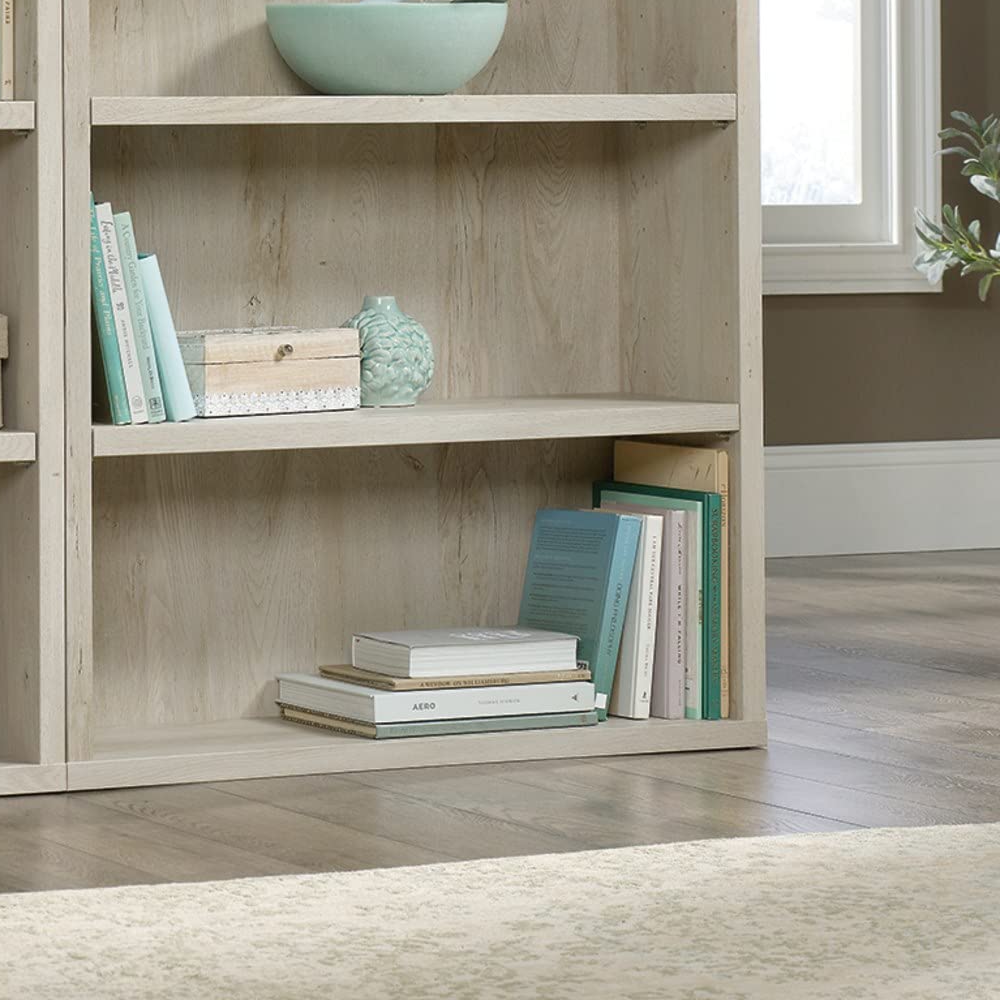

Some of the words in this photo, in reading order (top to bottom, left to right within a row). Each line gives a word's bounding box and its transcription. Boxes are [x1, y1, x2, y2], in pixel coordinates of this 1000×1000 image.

[100, 219, 113, 245] Eating
[126, 260, 141, 287] Garden
[134, 299, 145, 317] Your
[463, 676, 509, 686] WILLIAMSBURG
[412, 702, 436, 710] AERO
